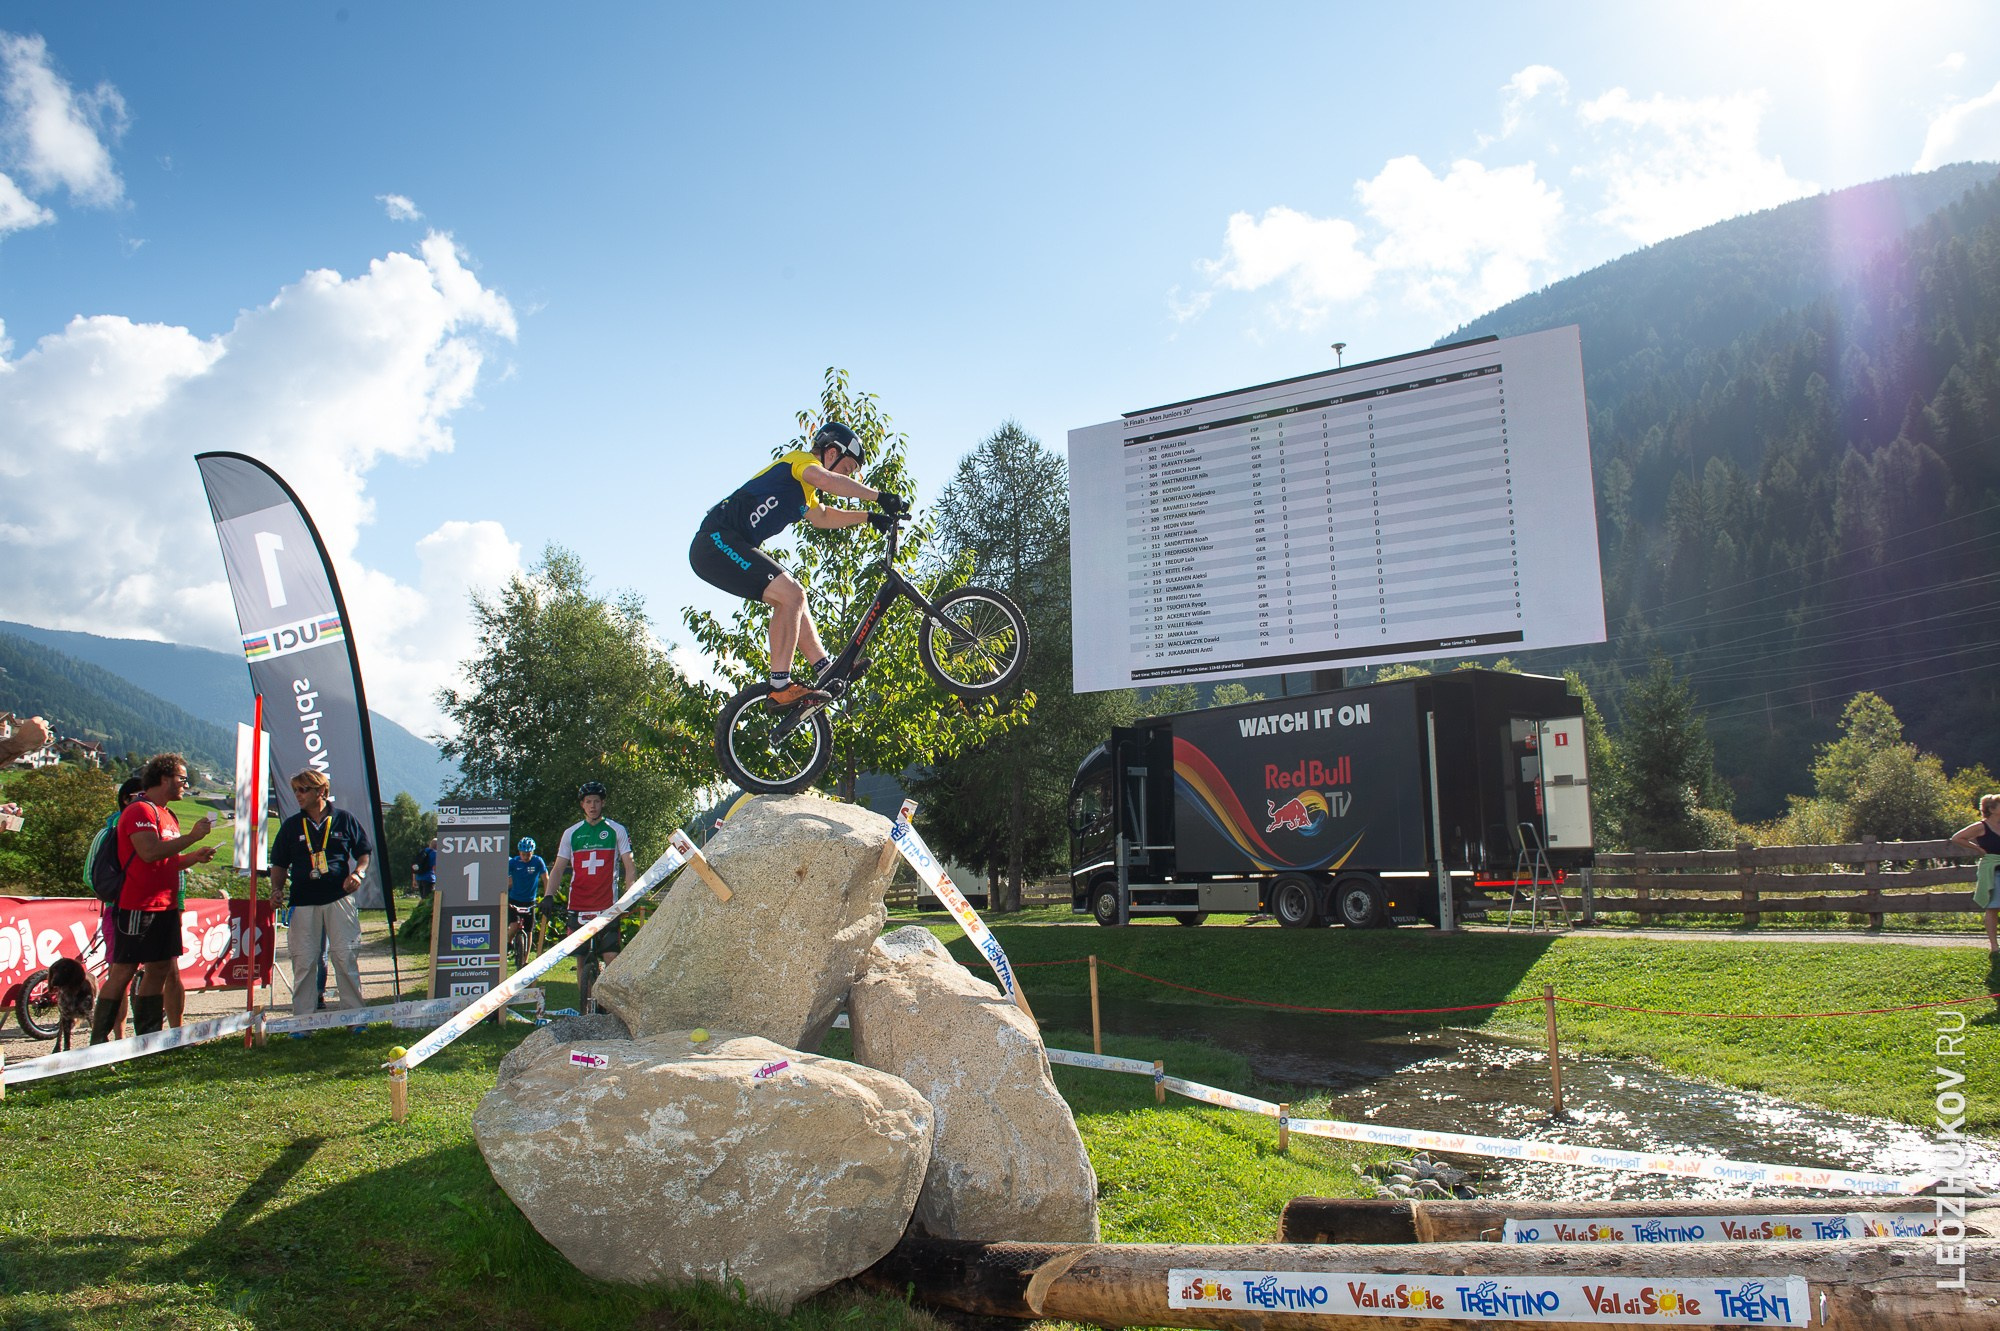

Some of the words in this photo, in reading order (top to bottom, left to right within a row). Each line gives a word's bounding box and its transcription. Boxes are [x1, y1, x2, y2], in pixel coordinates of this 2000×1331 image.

[1163, 411, 1182, 419] Juniors
[1239, 712, 1308, 737] WATCH
[1315, 708, 1333, 729] IT
[1338, 704, 1370, 726] ON
[1265, 760, 1306, 790] Red
[1309, 756, 1351, 786] Bull
[1325, 791, 1352, 817] TV
[442, 836, 504, 853] START
[464, 863, 480, 901] 1
[936, 873, 954, 896] Val
[949, 894, 958, 906] di
[462, 919, 485, 928] UCI
[457, 937, 484, 945] TRENTINO
[459, 957, 481, 966] UCI
[461, 986, 484, 996] UCI
[1554, 1224, 1578, 1241] Val
[1578, 1229, 1588, 1241] di
[1589, 1224, 1624, 1241] Sole
[1632, 1224, 1704, 1243] TRENTINO
[1720, 1221, 1749, 1239] Val
[1750, 1226, 1761, 1239] di
[1761, 1221, 1801, 1239] Sole
[1182, 1287, 1192, 1300] di
[1194, 1278, 1232, 1302] Sole
[1243, 1281, 1328, 1310] TRENTINO
[1348, 1282, 1378, 1309] Val
[1382, 1293, 1395, 1308] di
[1397, 1285, 1444, 1310] Sole
[1456, 1287, 1560, 1317] TRENTINO
[1582, 1286, 1620, 1315] Val
[1624, 1299, 1639, 1314] di
[1641, 1287, 1701, 1316] Sole
